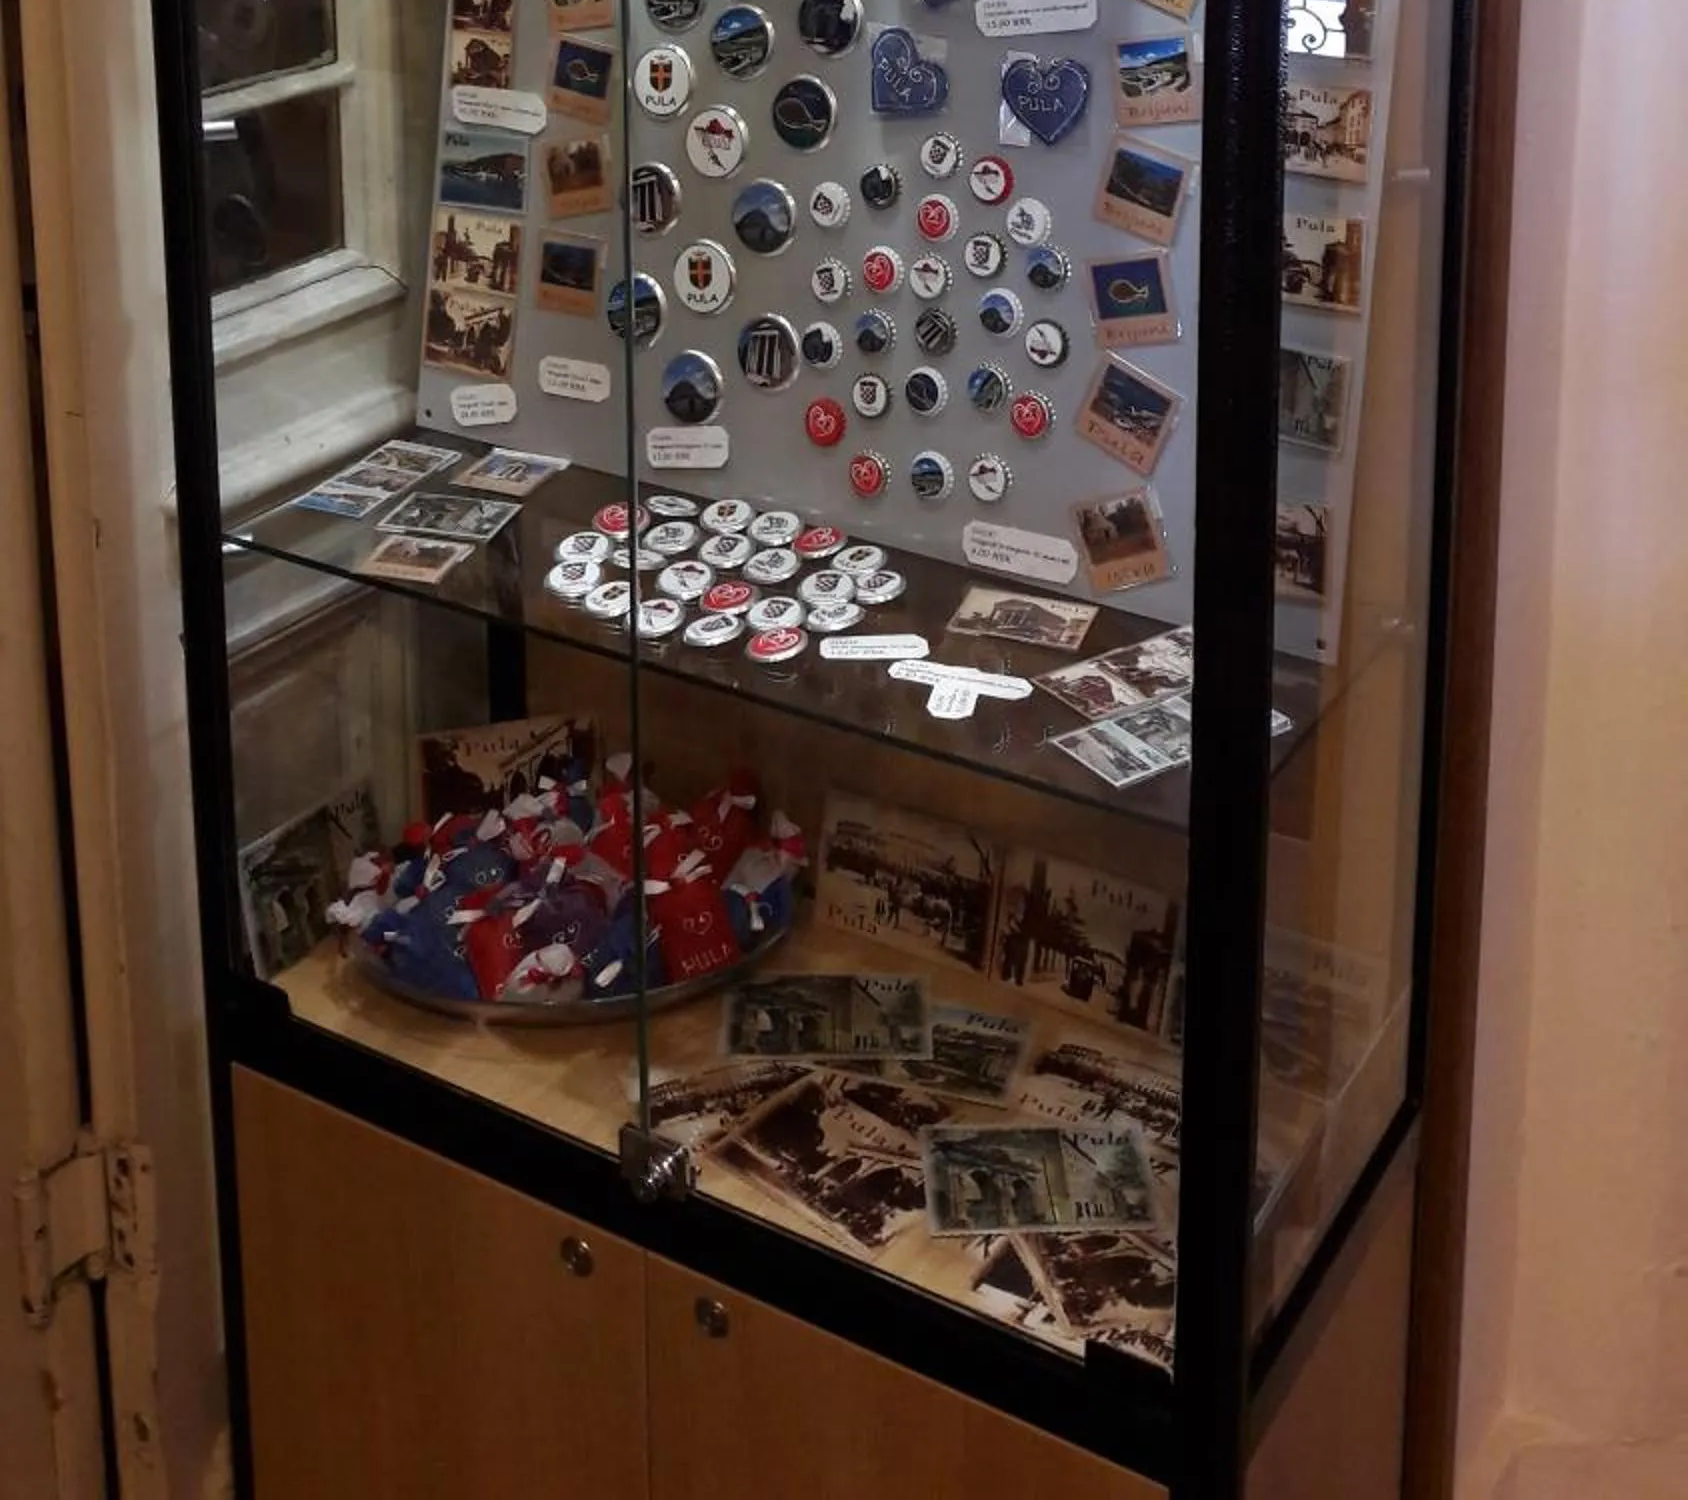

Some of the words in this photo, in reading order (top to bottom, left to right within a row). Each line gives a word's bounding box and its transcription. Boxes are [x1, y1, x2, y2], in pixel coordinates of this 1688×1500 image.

[879, 57, 912, 102] PULA
[645, 95, 678, 106] PULA
[1017, 95, 1067, 113] PULA
[1298, 88, 1339, 106] Pula
[1296, 217, 1336, 234] Pula
[686, 292, 719, 305] PULA
[829, 902, 878, 934] Pula
[965, 1012, 1020, 1034] Pula
[1020, 1093, 1079, 1122] Pula
[833, 1105, 888, 1147] Pula
[1071, 1131, 1131, 1147] Pula
